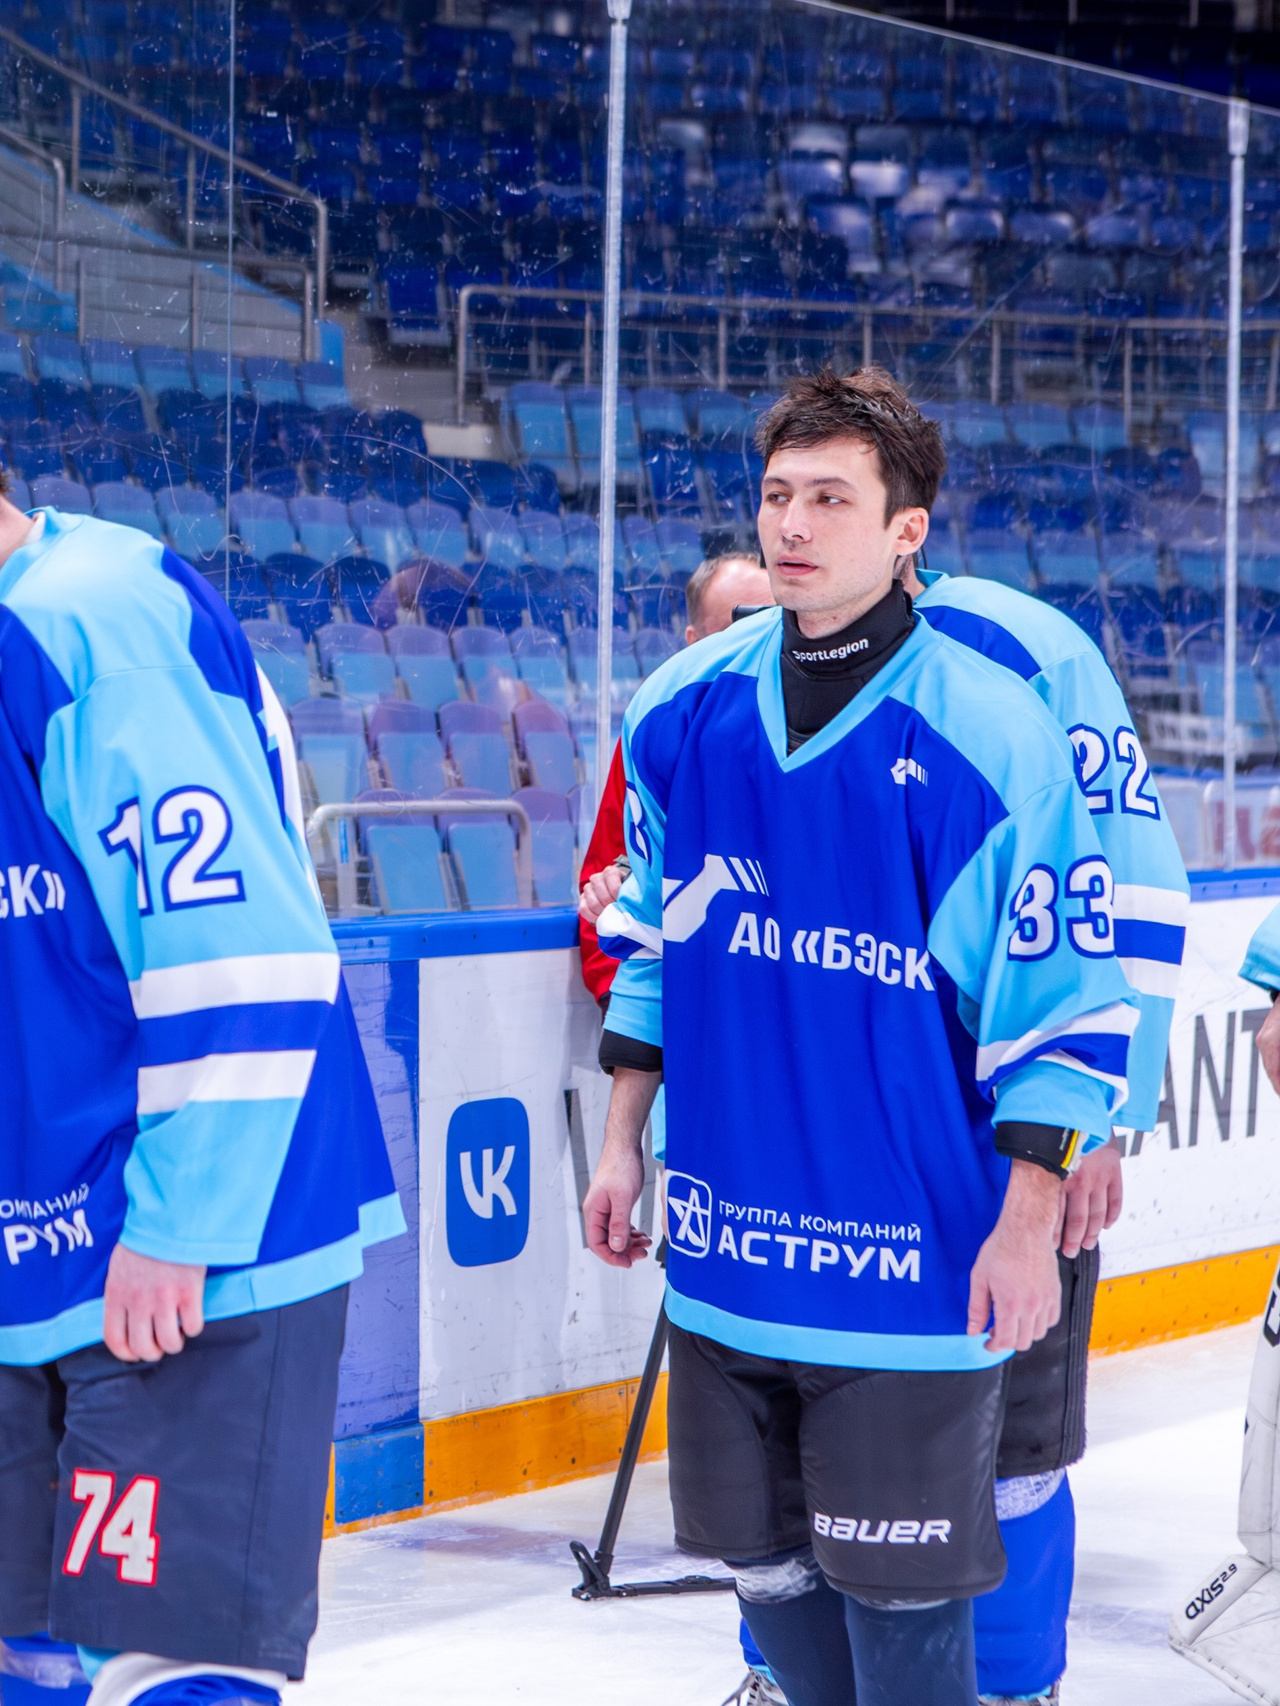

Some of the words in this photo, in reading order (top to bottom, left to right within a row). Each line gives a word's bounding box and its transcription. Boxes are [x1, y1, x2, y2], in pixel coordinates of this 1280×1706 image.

[1066, 723, 1161, 821] 22
[97, 784, 247, 917] 12
[727, 911, 781, 961] АО
[1007, 854, 1117, 962] 33
[718, 1224, 921, 1283] АСТРУМ
[719, 1200, 793, 1228] ГРУППА
[799, 1214, 921, 1242] КОМПАНИЙ
[61, 1467, 161, 1587] 74
